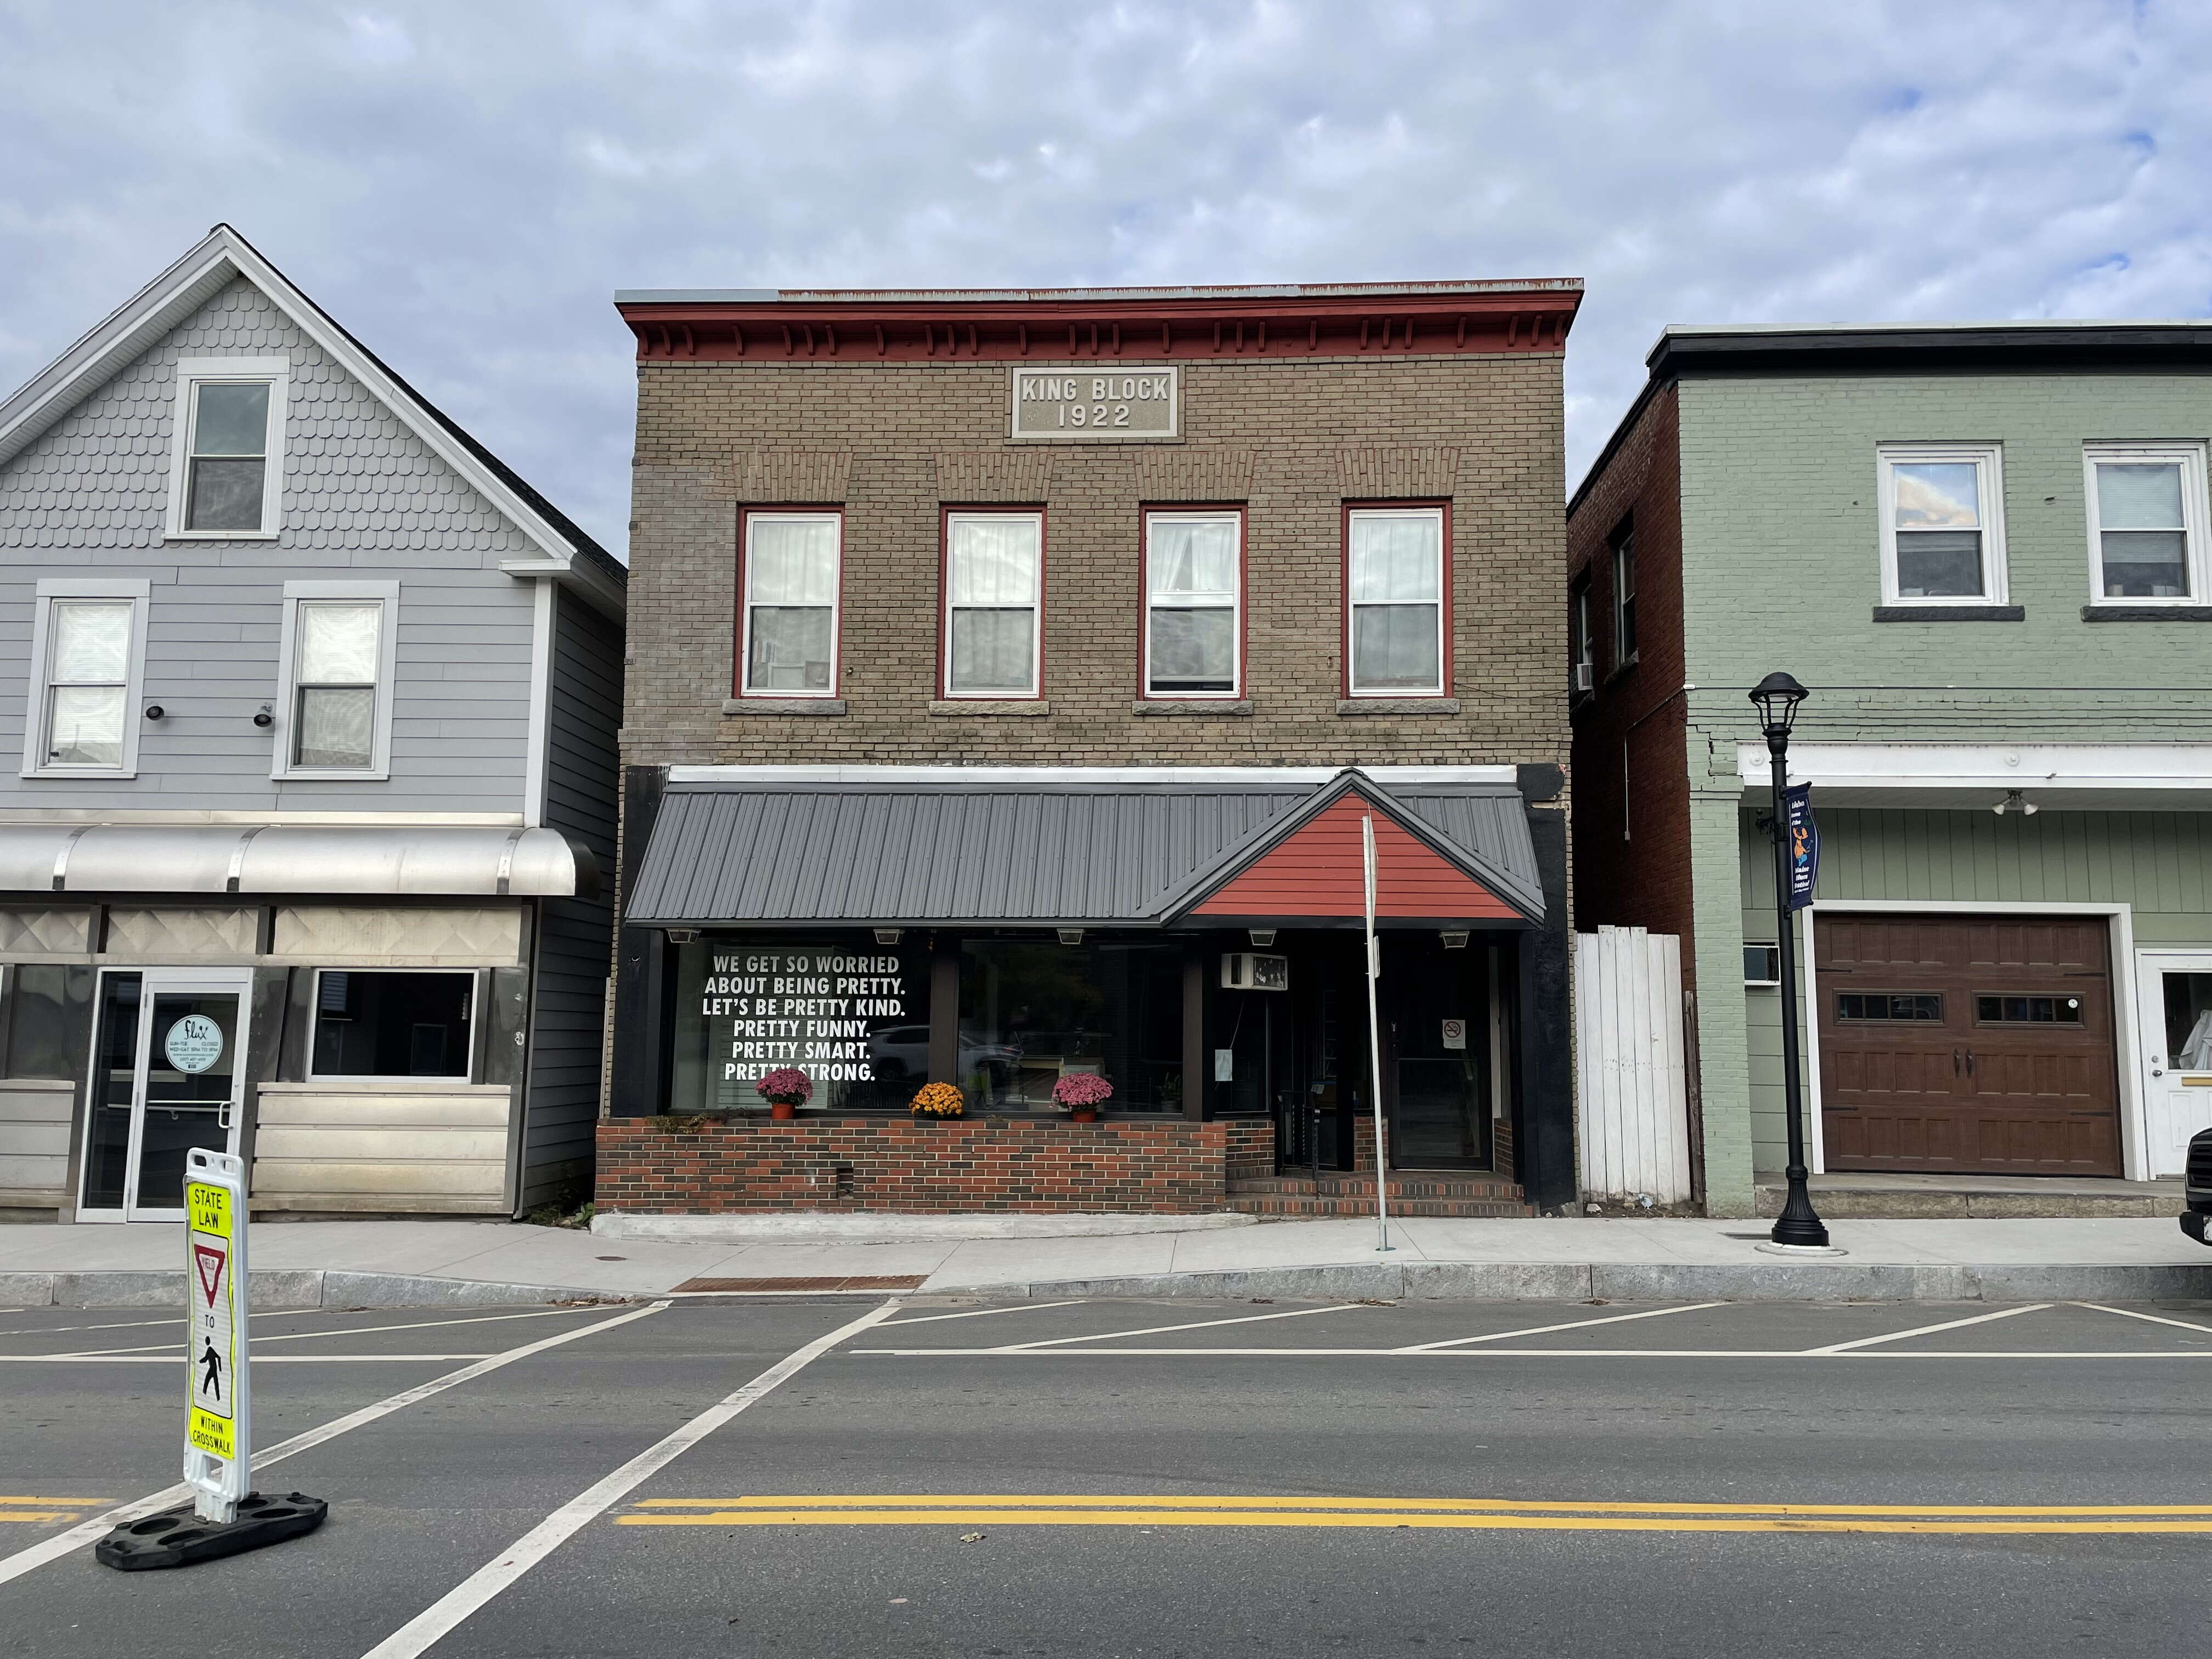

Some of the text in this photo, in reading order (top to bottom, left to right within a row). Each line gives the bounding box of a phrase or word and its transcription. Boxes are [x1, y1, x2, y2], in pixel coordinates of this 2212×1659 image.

[1023, 377, 1168, 401] KING BLOCK
[1059, 404, 1130, 427] 1922
[713, 956, 899, 973] WE GET SO WORRIED
[704, 977, 905, 995] ABOUT BEING PRETTY.
[755, 999, 776, 1015] BE
[784, 999, 849, 1015] PRETTY
[856, 1000, 905, 1016] KIND.
[733, 1020, 870, 1037] PRETTY FUNNY.
[732, 1042, 870, 1059] PRETTY SMART.
[798, 1063, 875, 1081] STRONG.
[194, 1188, 222, 1210] STATE
[199, 1210, 218, 1229] LAW
[202, 1257, 215, 1271] YIELD
[205, 1314, 215, 1328] TO
[200, 1415, 223, 1435] WITHIN
[193, 1429, 230, 1454] CROSSWALK
